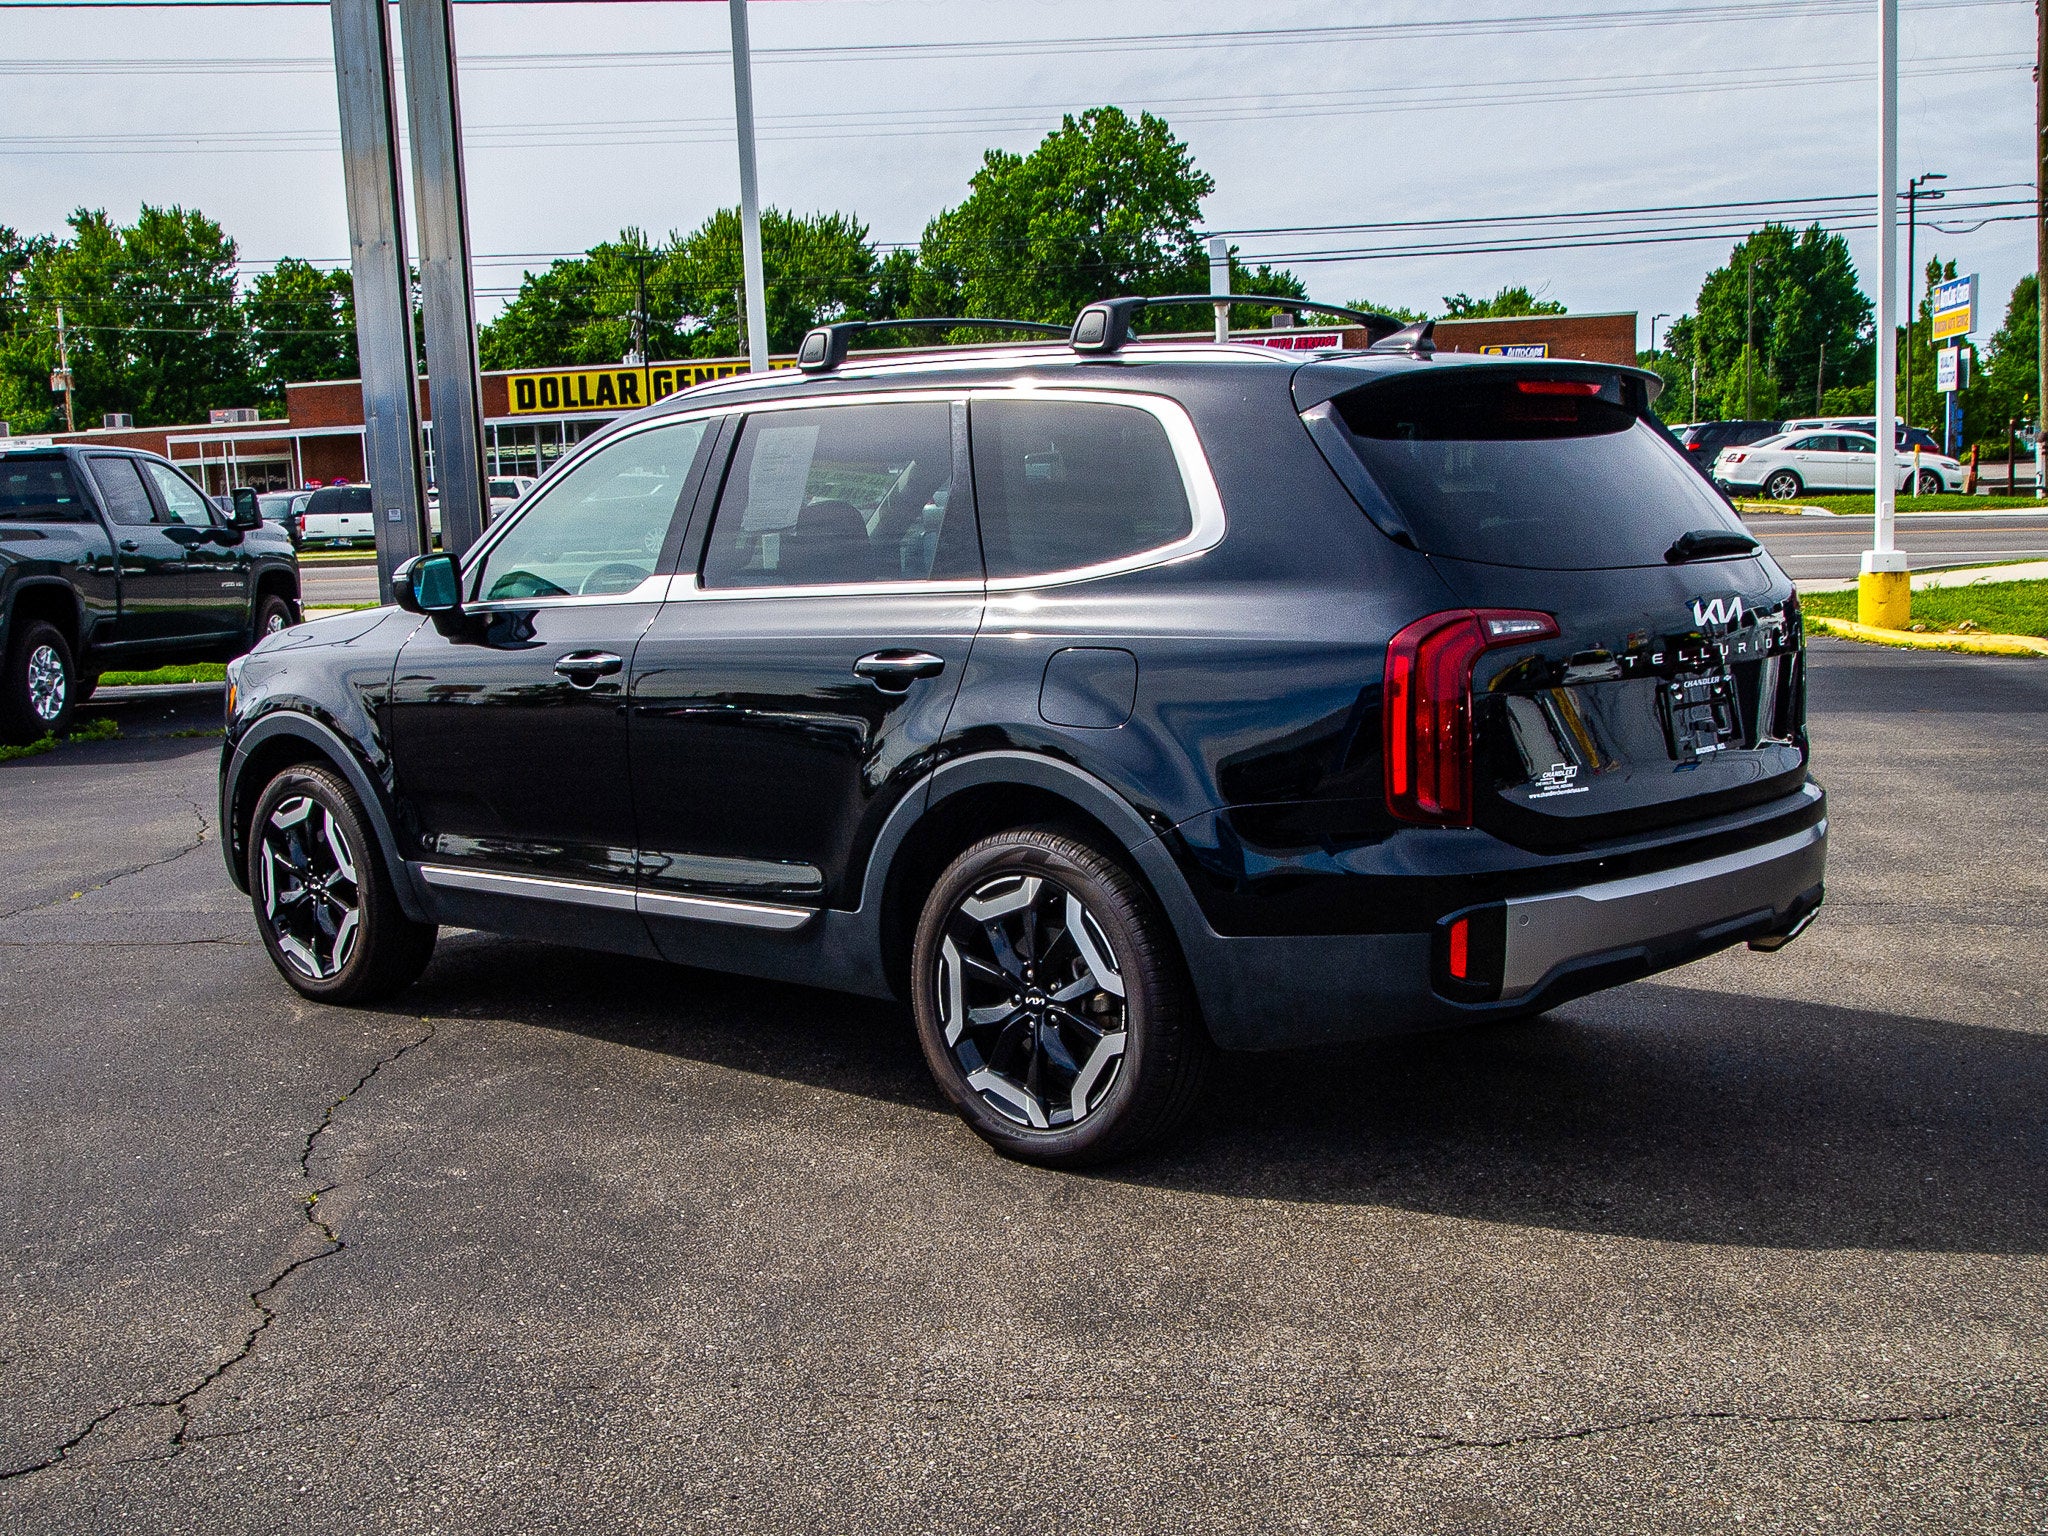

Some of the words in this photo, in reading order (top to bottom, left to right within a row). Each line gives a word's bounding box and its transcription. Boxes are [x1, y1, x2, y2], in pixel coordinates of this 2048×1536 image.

[1266, 338, 1294, 350] AUTO
[1294, 335, 1339, 350] SERVICE
[515, 371, 641, 411] DOLLAR
[1625, 637, 1787, 669] TELLURIDE
[1683, 675, 1721, 689] CHANDLER
